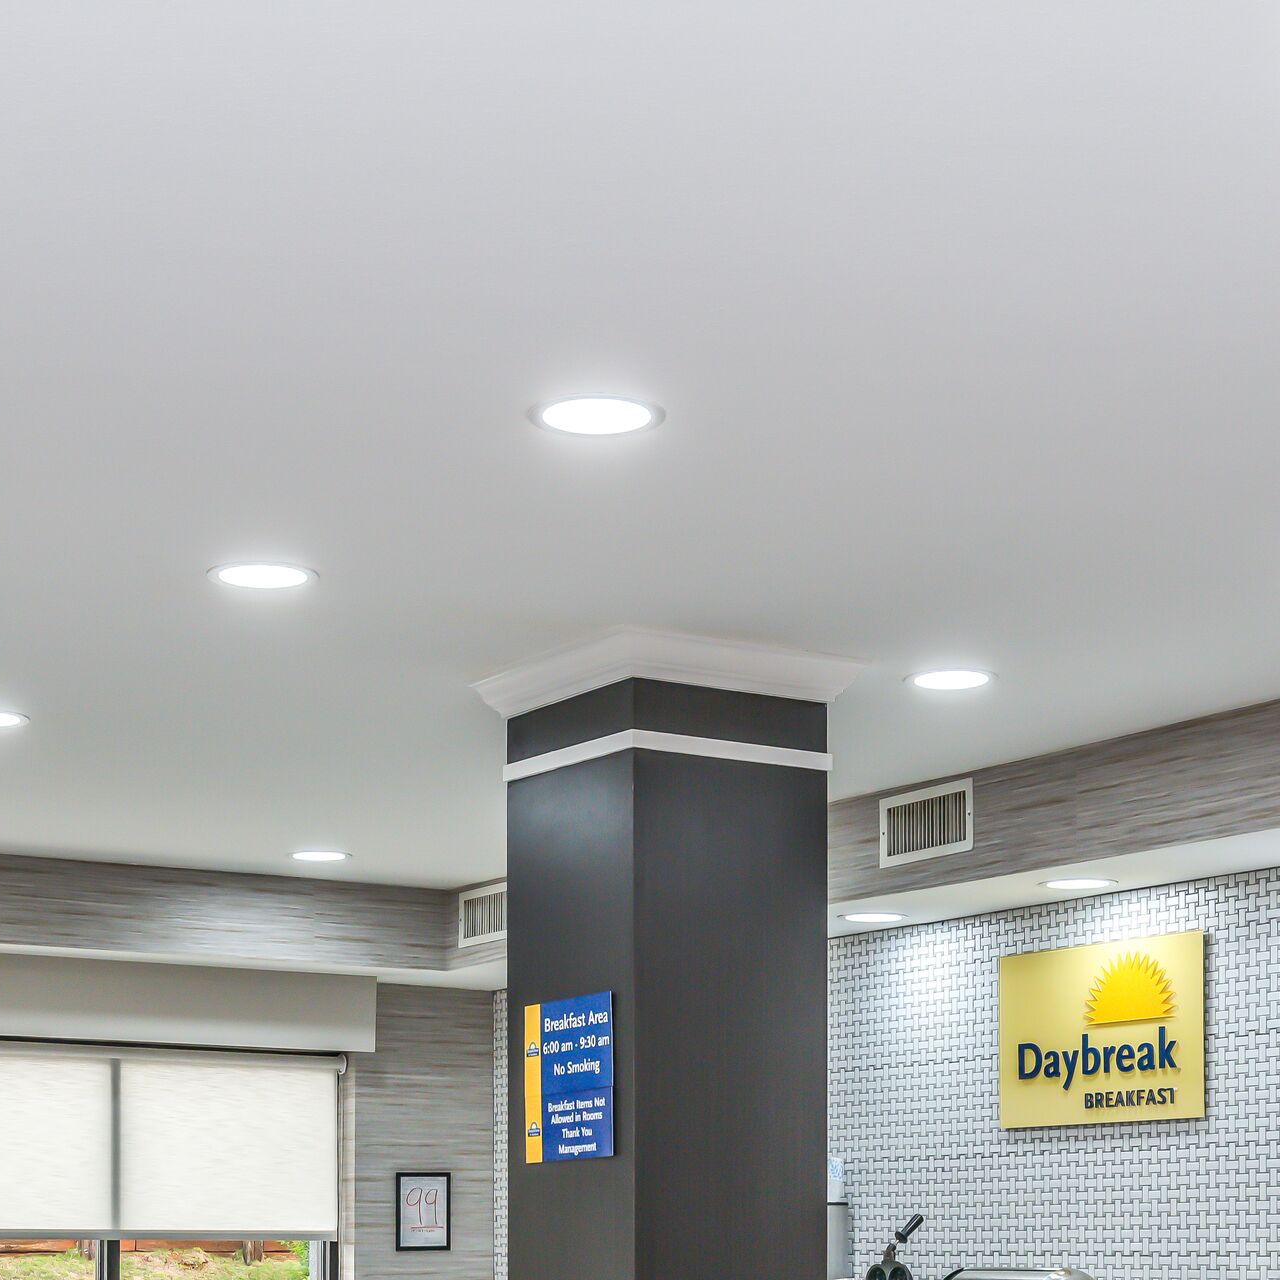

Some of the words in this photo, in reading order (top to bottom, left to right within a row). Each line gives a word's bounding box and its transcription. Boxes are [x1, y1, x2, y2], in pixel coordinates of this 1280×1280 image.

[544, 1012, 586, 1033] Breakfast
[587, 1010, 609, 1026] Area
[542, 1041, 560, 1055] 6:00
[561, 1041, 573, 1052] am
[579, 1034, 596, 1050] 9:30
[597, 1035, 610, 1047] am
[553, 1063, 566, 1076] No
[567, 1058, 600, 1074] Smoking
[1017, 1026, 1178, 1091] Daybreak
[547, 1099, 575, 1113] Breakfast
[576, 1099, 593, 1109] Items
[594, 1097, 606, 1107] Not
[1084, 1087, 1176, 1109] BREAKFAST
[551, 1112, 574, 1124] Allowed
[575, 1112, 581, 1122] in
[582, 1111, 603, 1121] Rooms
[562, 1127, 580, 1138] Thank
[581, 1127, 593, 1137] You
[558, 1142, 597, 1156] Management
[406, 1187, 438, 1226] 99
